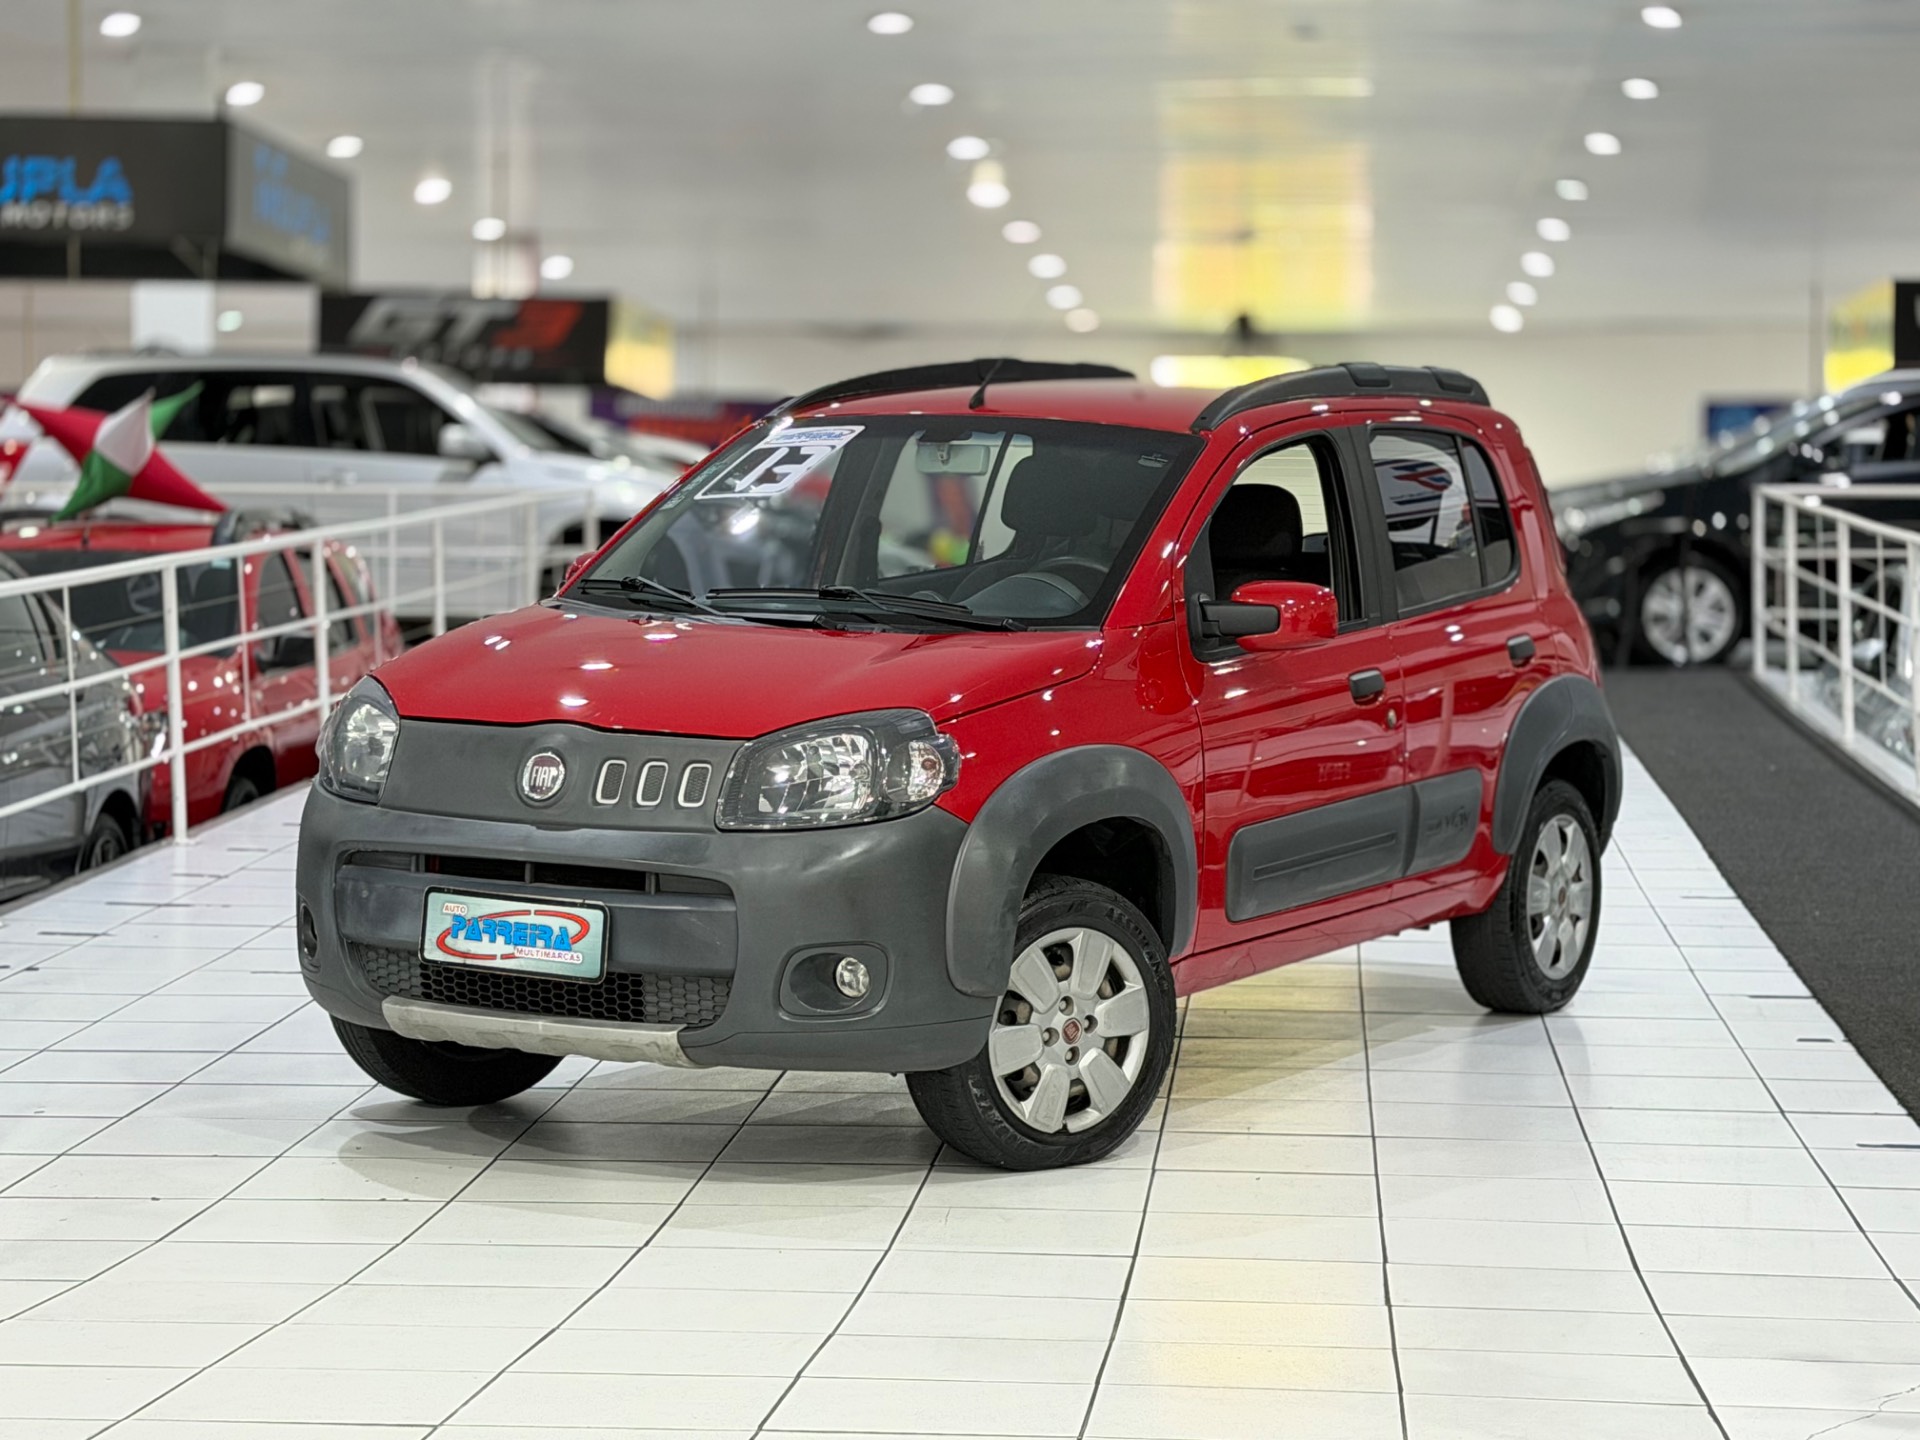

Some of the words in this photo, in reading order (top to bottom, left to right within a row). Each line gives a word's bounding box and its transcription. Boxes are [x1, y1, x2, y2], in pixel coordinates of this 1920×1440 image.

[735, 446, 833, 493] 13
[530, 766, 558, 787] FIAT
[444, 904, 467, 914] AUTO
[450, 914, 573, 951] PARREIRA
[516, 947, 581, 963] MULTIMARCAS
